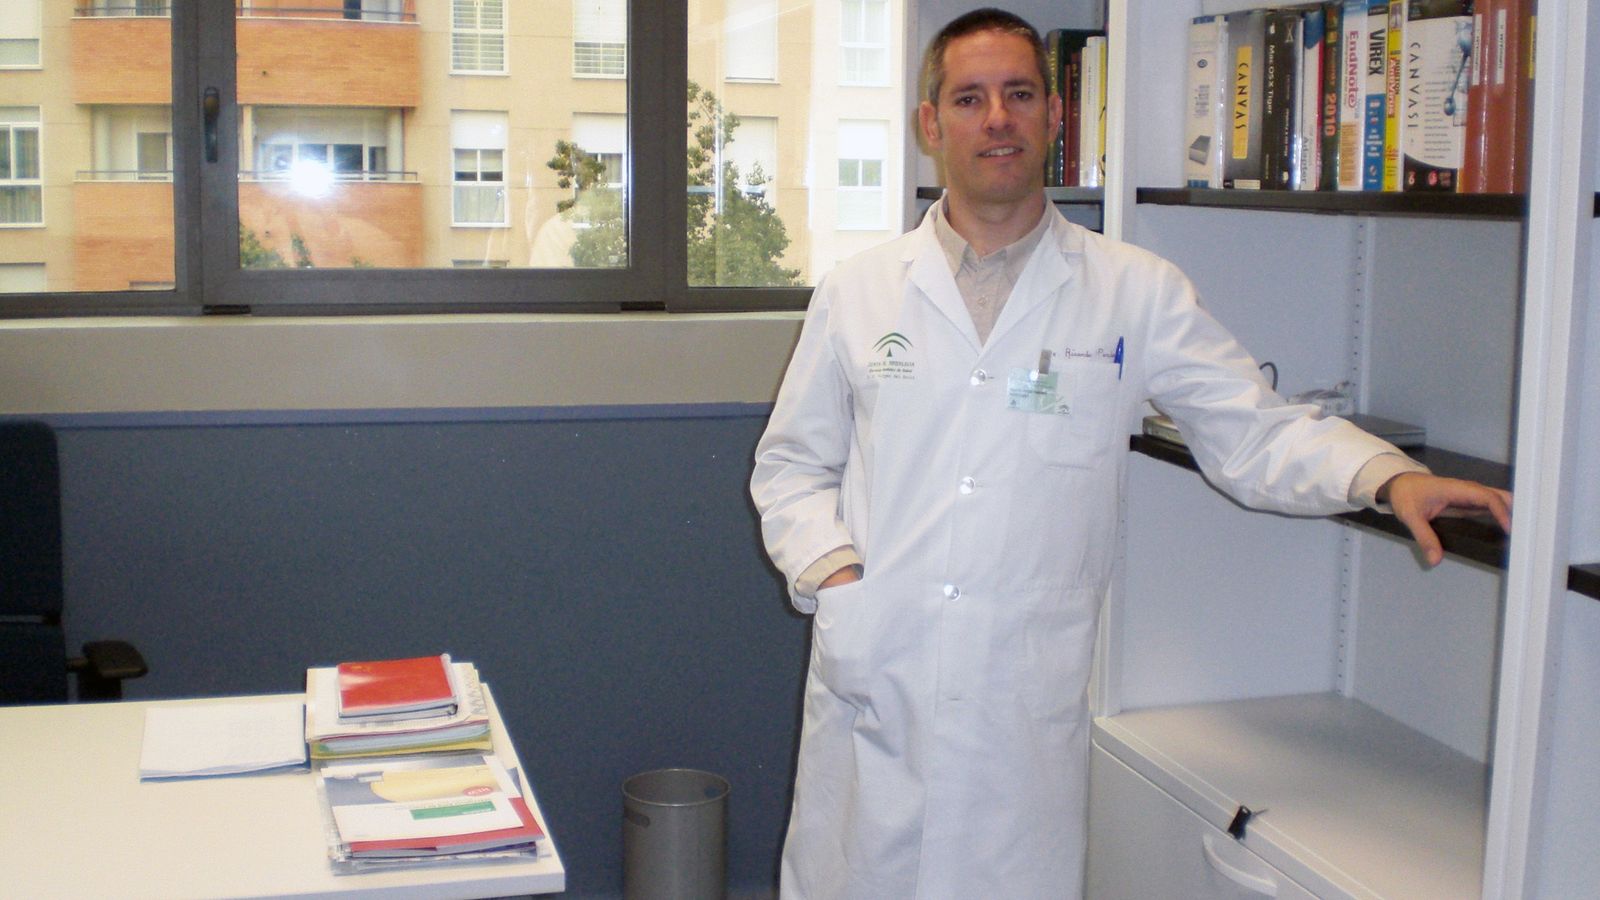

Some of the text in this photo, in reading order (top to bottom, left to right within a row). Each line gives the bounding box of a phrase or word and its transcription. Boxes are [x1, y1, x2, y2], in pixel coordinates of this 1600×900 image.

[1348, 30, 1360, 109] EndNote
[1368, 28, 1385, 77] VIREX
[1236, 62, 1249, 130] CANVAS
[1324, 93, 1337, 137] 2010
